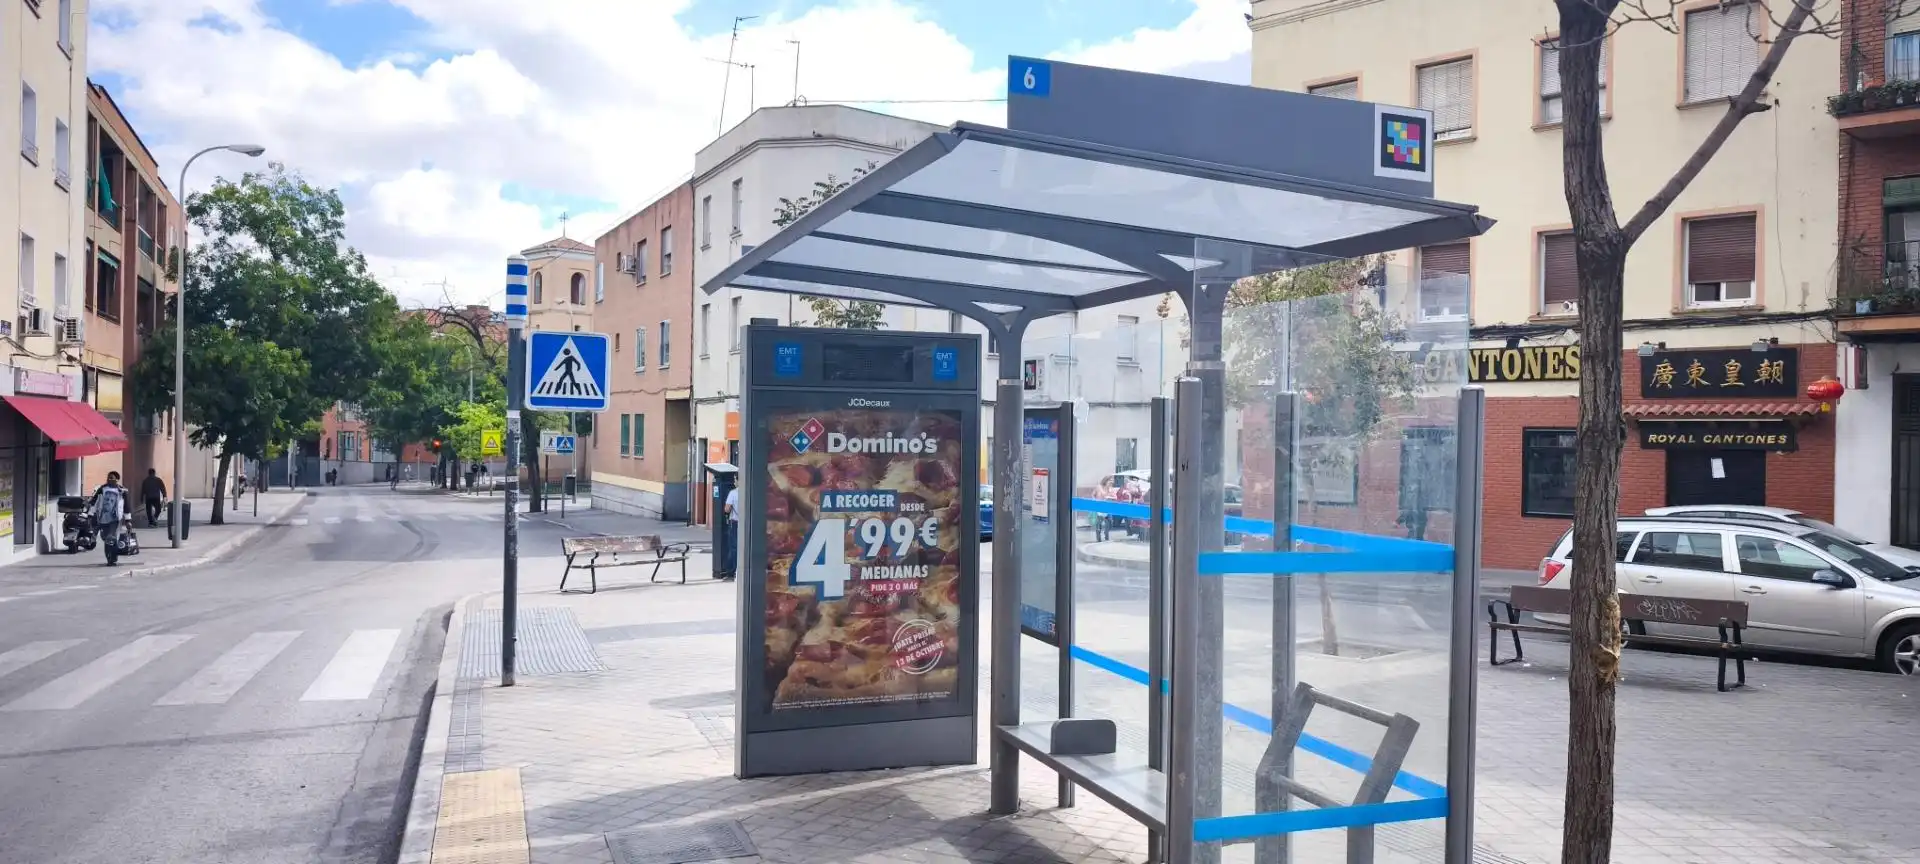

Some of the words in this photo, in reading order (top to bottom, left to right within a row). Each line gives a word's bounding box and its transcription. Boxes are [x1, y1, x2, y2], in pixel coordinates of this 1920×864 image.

[1023, 66, 1036, 90] 6
[778, 347, 797, 355] EMT
[1424, 346, 1581, 381] CANTONES
[1649, 358, 1785, 389] 廣東皇朝
[847, 398, 891, 408] JCDecaux
[827, 431, 938, 454] Domino's
[1648, 434, 1697, 444] ROYAL
[1703, 434, 1788, 444] CANTONES
[822, 494, 832, 508] A
[836, 494, 895, 508] RECOGER
[900, 503, 925, 512] DESDE
[860, 565, 929, 580] MEDIANAS
[871, 583, 887, 592] PIDE
